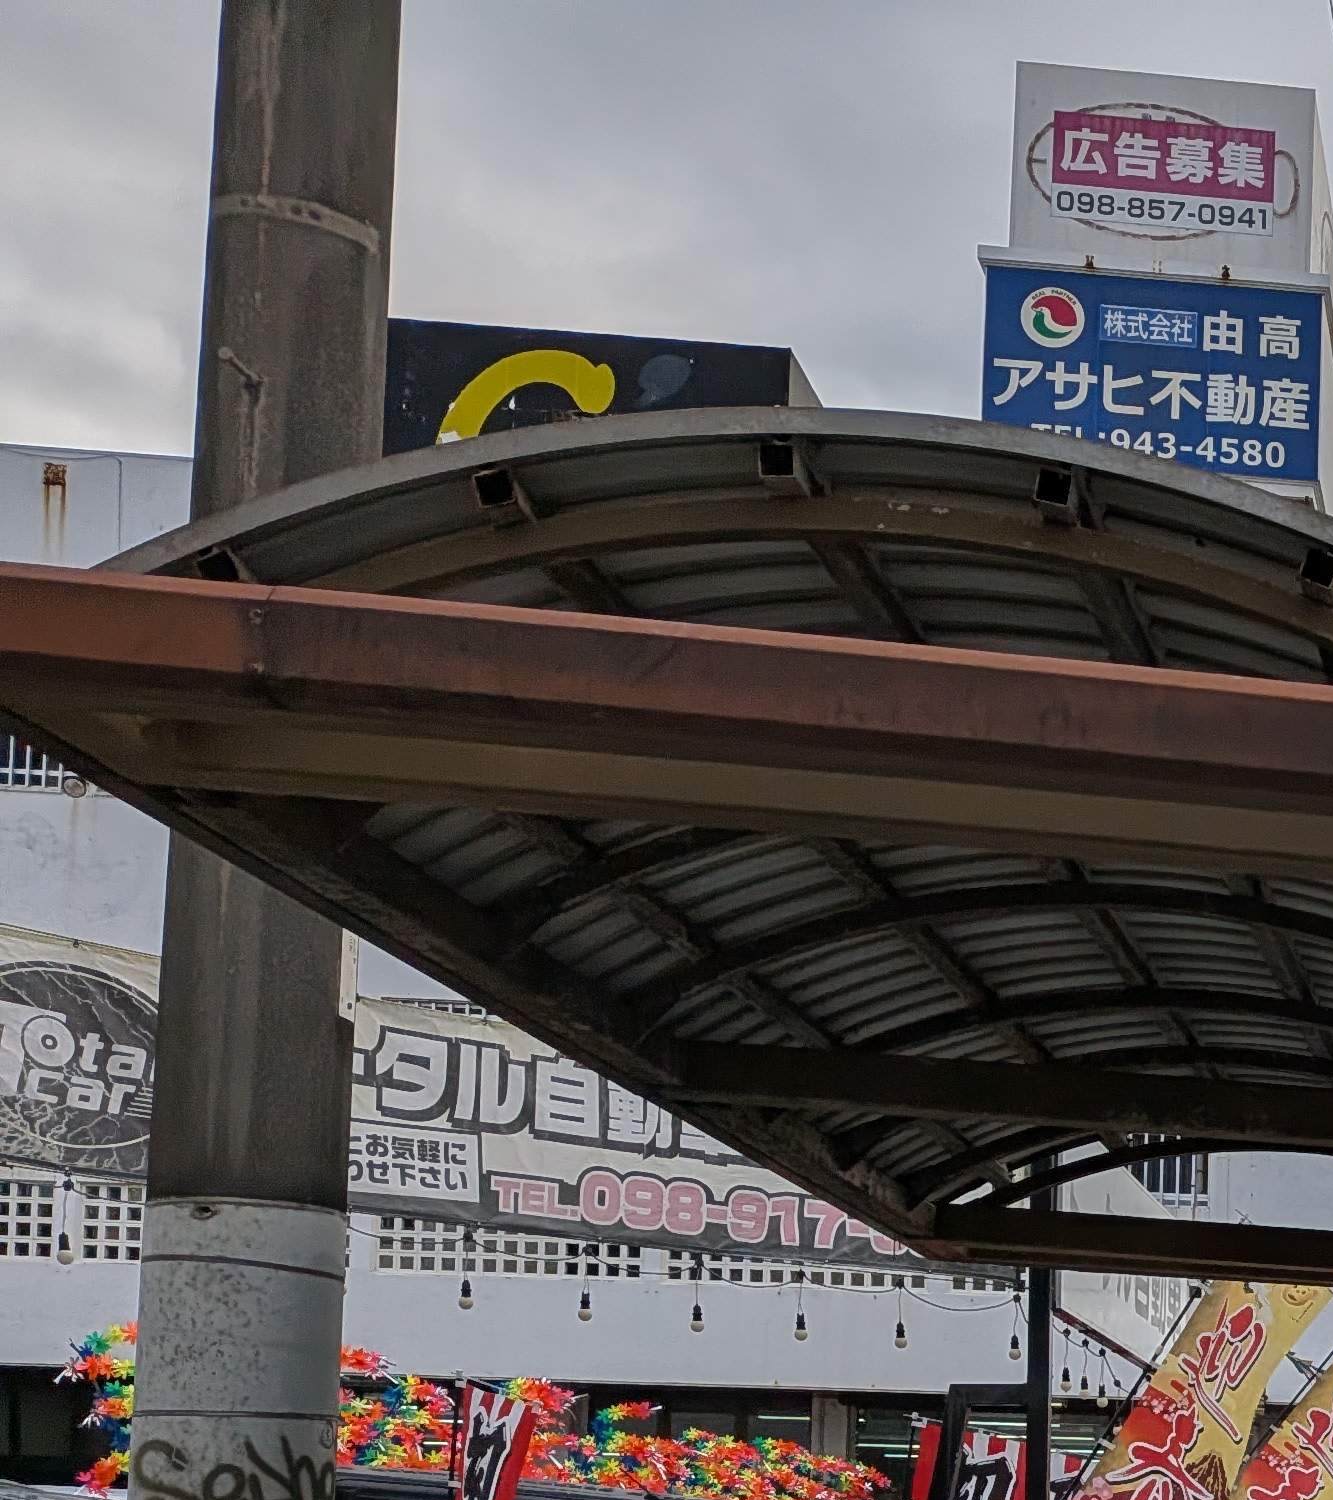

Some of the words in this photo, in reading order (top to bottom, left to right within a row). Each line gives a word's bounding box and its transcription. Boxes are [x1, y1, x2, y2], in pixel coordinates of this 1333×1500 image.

[1060, 127, 1265, 189] 広告募集
[1056, 190, 1268, 230] 098-857-0941
[1104, 310, 1193, 343] 株式会社
[1202, 310, 1302, 360] 由高
[993, 357, 1310, 430] アサヒ不動産
[1031, 423, 1285, 468] :943-4580
[352, 1026, 744, 1156] タル自動
